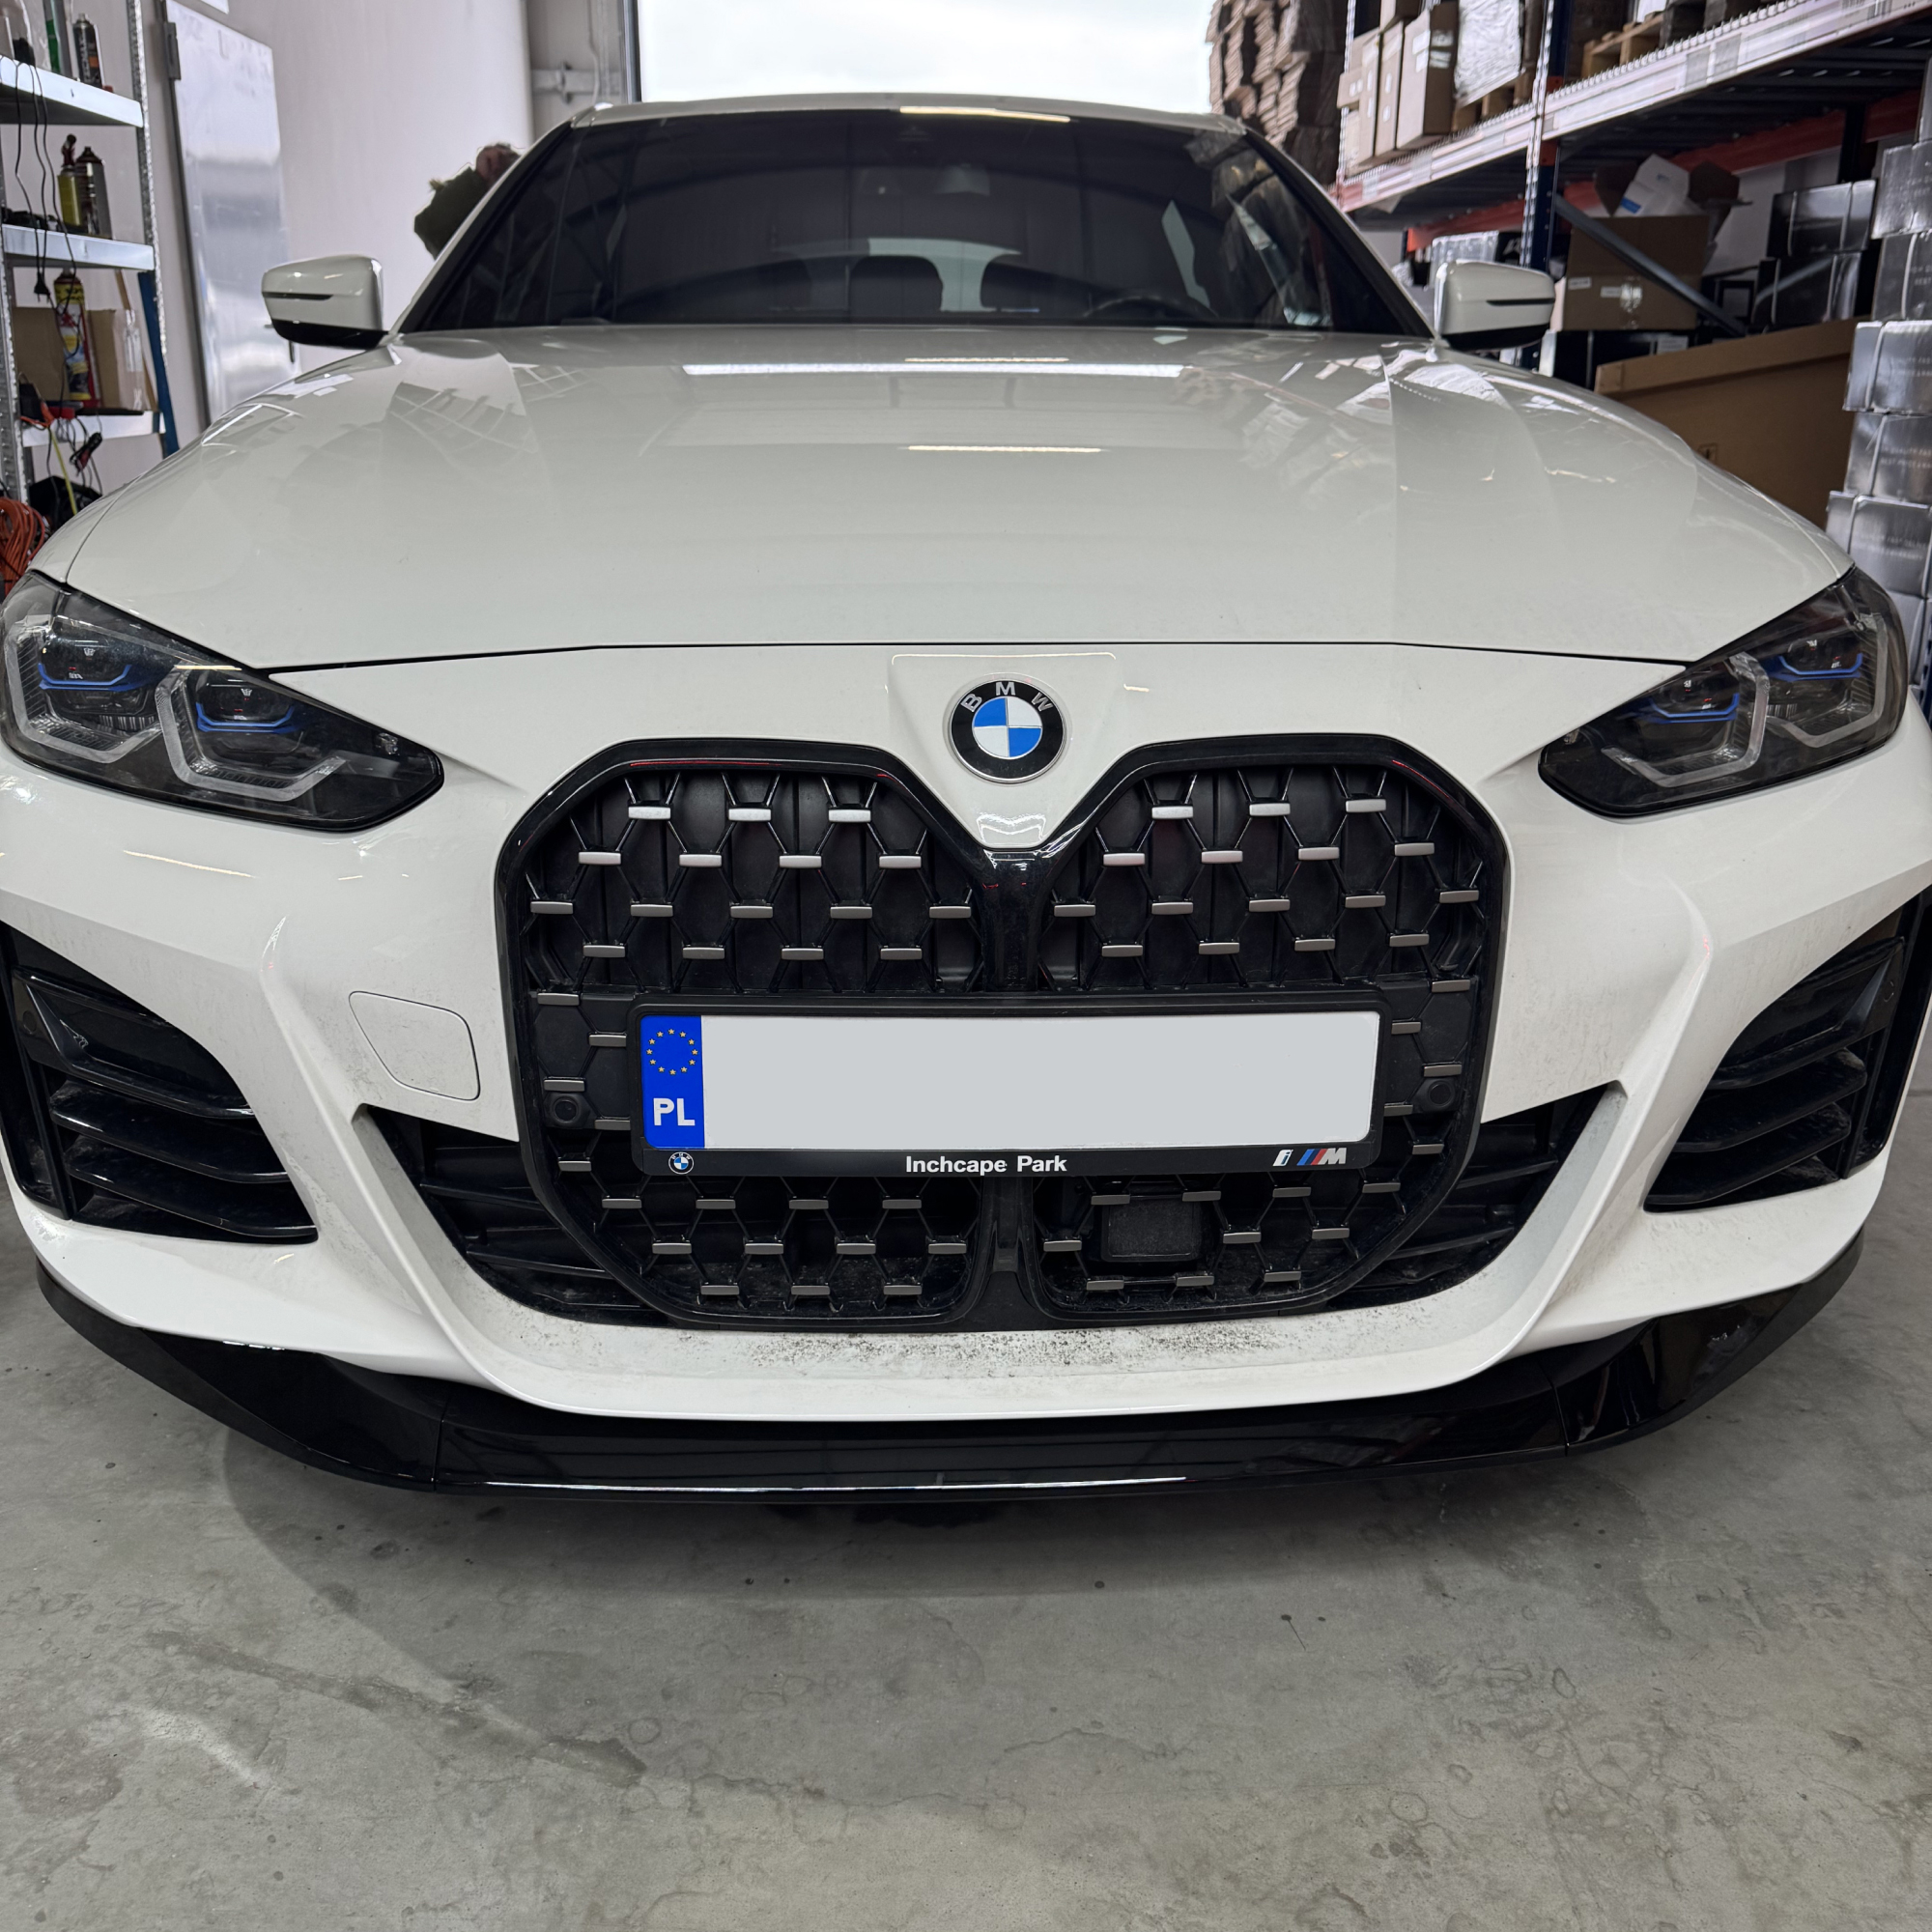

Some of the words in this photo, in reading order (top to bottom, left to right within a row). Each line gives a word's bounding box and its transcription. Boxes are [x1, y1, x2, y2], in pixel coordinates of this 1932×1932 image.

[960, 681, 1054, 713] BMW
[653, 1097, 696, 1126] PL
[906, 1155, 1008, 1177] Inchcape
[1017, 1154, 1067, 1173] Park
